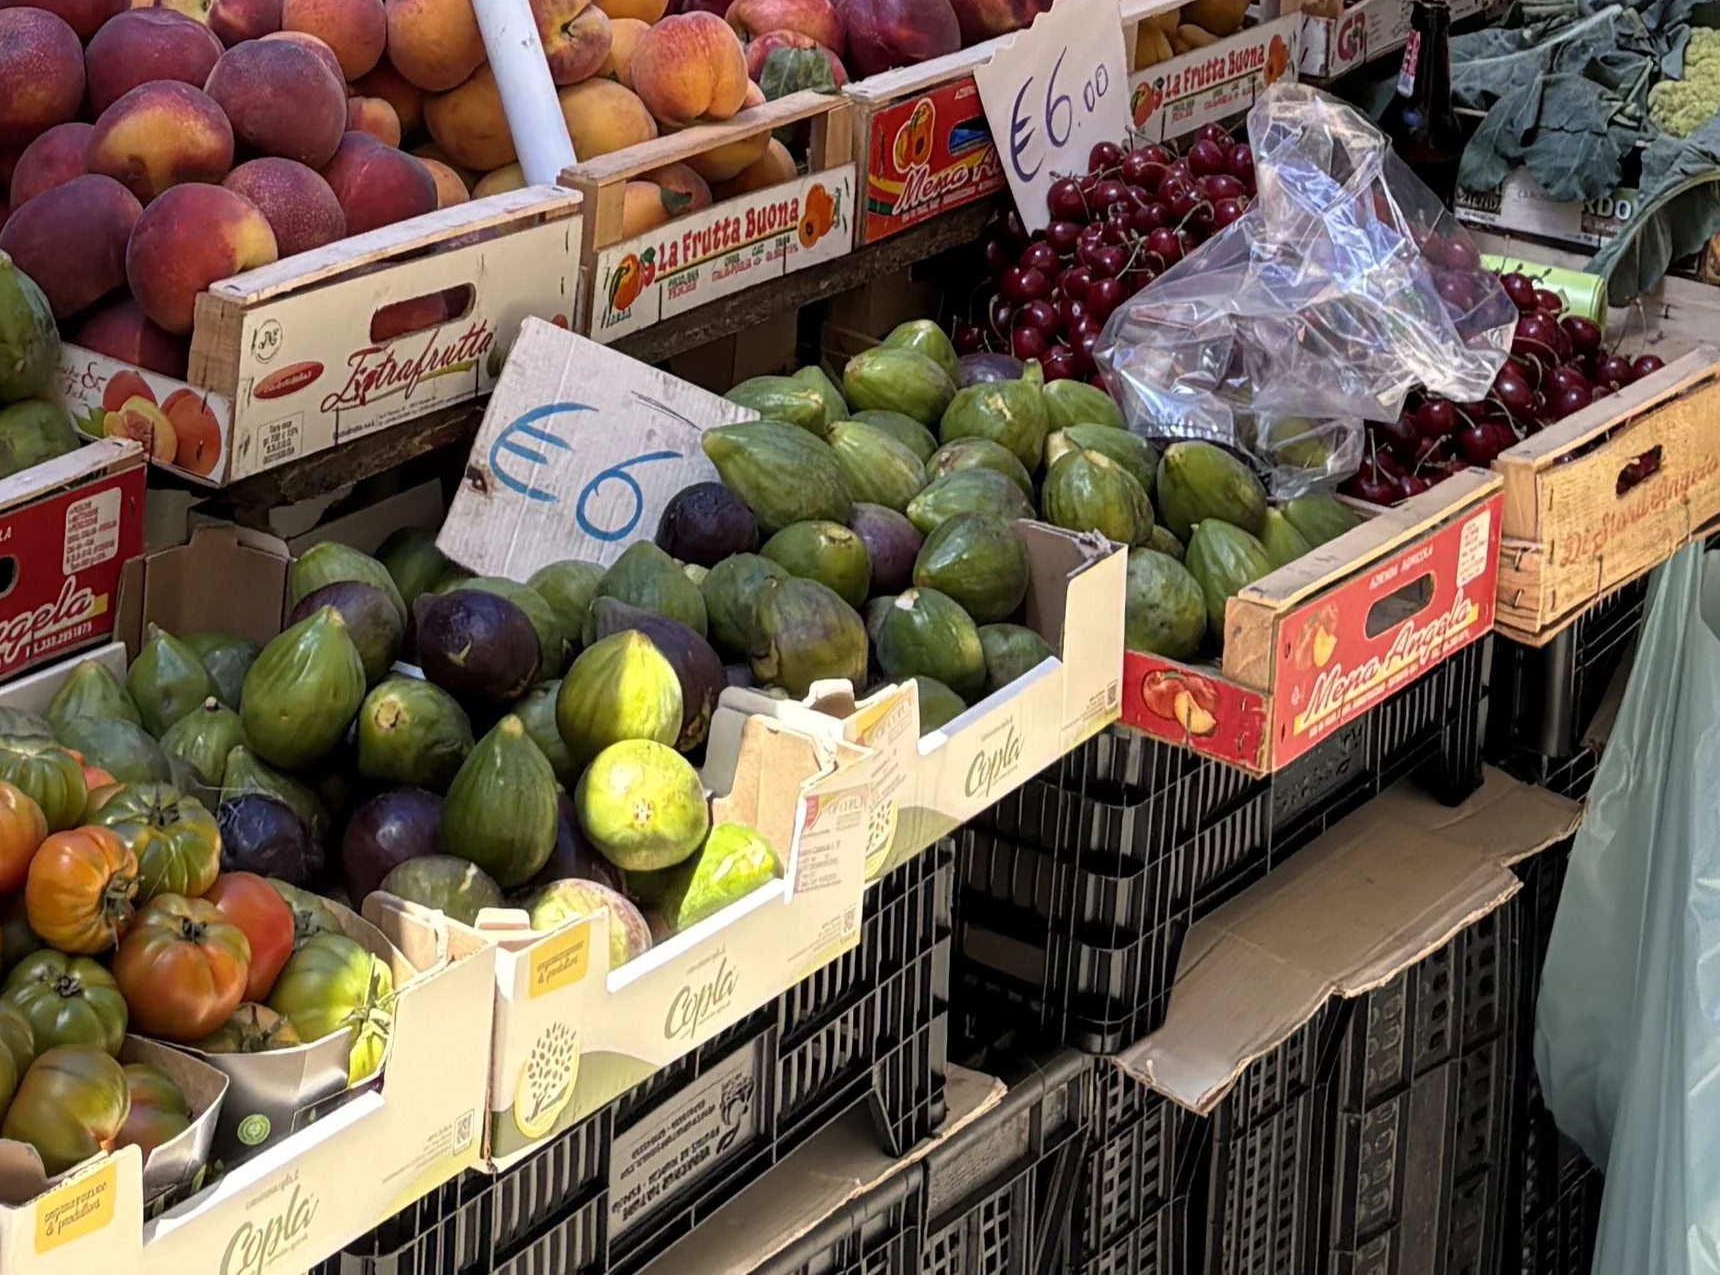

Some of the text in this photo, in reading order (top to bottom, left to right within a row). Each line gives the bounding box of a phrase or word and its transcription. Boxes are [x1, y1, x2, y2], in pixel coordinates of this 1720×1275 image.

[1183, 57, 1225, 93] Frutta
[1228, 44, 1265, 76] Buona
[682, 216, 741, 263] Frutta
[744, 197, 800, 239] Buona
[1384, 587, 1473, 672] Angela
[964, 724, 1025, 797] Copla
[664, 956, 739, 1040] Copla
[219, 1182, 320, 1275] Copla
